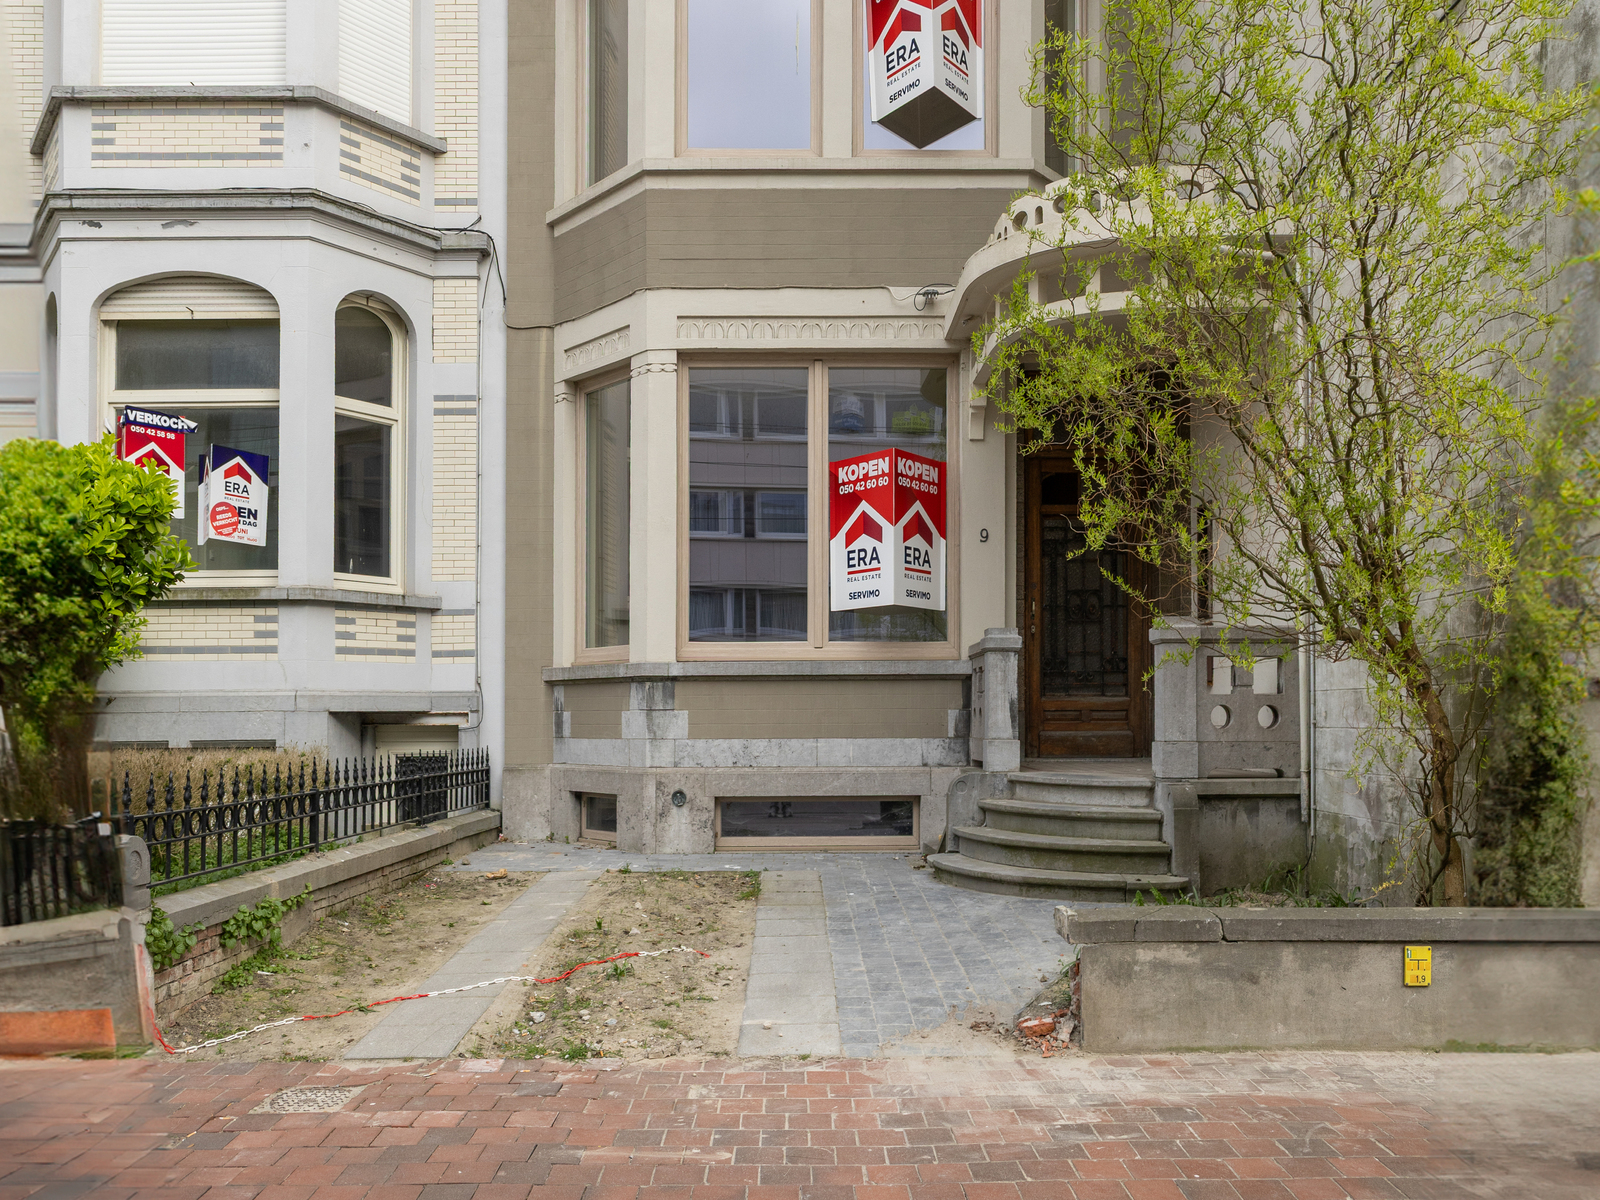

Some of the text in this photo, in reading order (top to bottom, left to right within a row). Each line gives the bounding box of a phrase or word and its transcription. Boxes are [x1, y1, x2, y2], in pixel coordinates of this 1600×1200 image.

[886, 38, 920, 73] ERA
[943, 34, 969, 71] ERA
[887, 62, 921, 87] REAL ESTATE
[943, 62, 969, 85] REAL ESTATE
[889, 78, 921, 104] SERVIMO
[945, 78, 969, 102] SERVIMO
[130, 425, 145, 434] 050
[166, 432, 175, 440] 98
[838, 456, 889, 484] KOPEN
[897, 456, 939, 484] KOPEN
[224, 481, 250, 496] ERA
[839, 476, 889, 495] 050 42 60 60
[898, 476, 938, 495] 050 42 60 60
[980, 528, 989, 543] 9
[847, 546, 881, 568] ERA
[904, 546, 932, 568] ERA
[847, 573, 881, 583] REAL ESTATE
[916, 575, 932, 583] ESTATE
[848, 589, 880, 600] SERVIMO
[905, 589, 931, 600] SERVIMO
